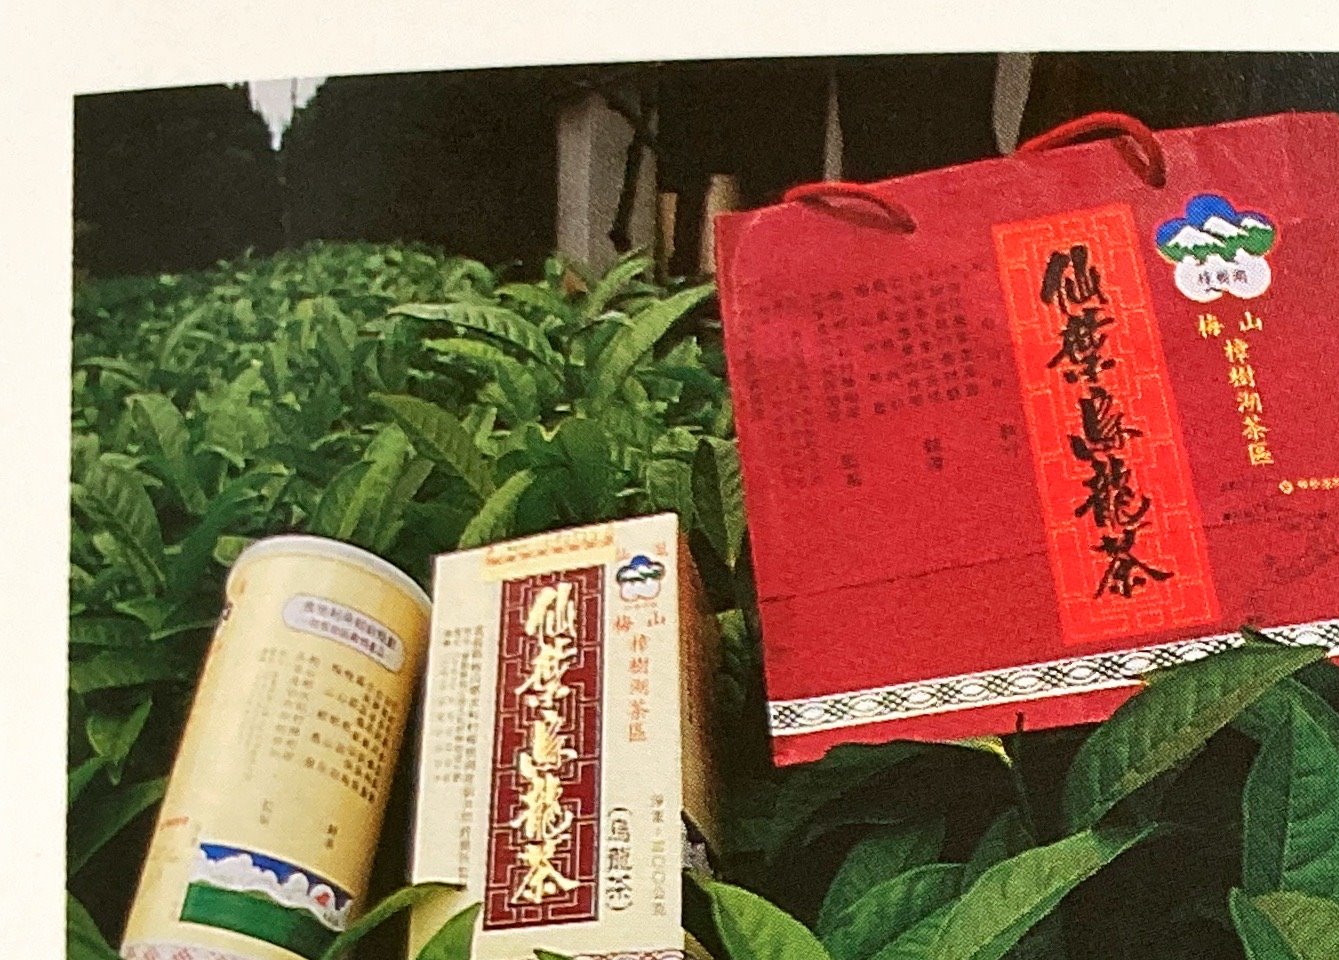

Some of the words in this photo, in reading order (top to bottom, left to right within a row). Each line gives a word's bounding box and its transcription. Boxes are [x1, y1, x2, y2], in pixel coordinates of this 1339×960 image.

[1224, 338, 1274, 465] 樟樹湖茶區
